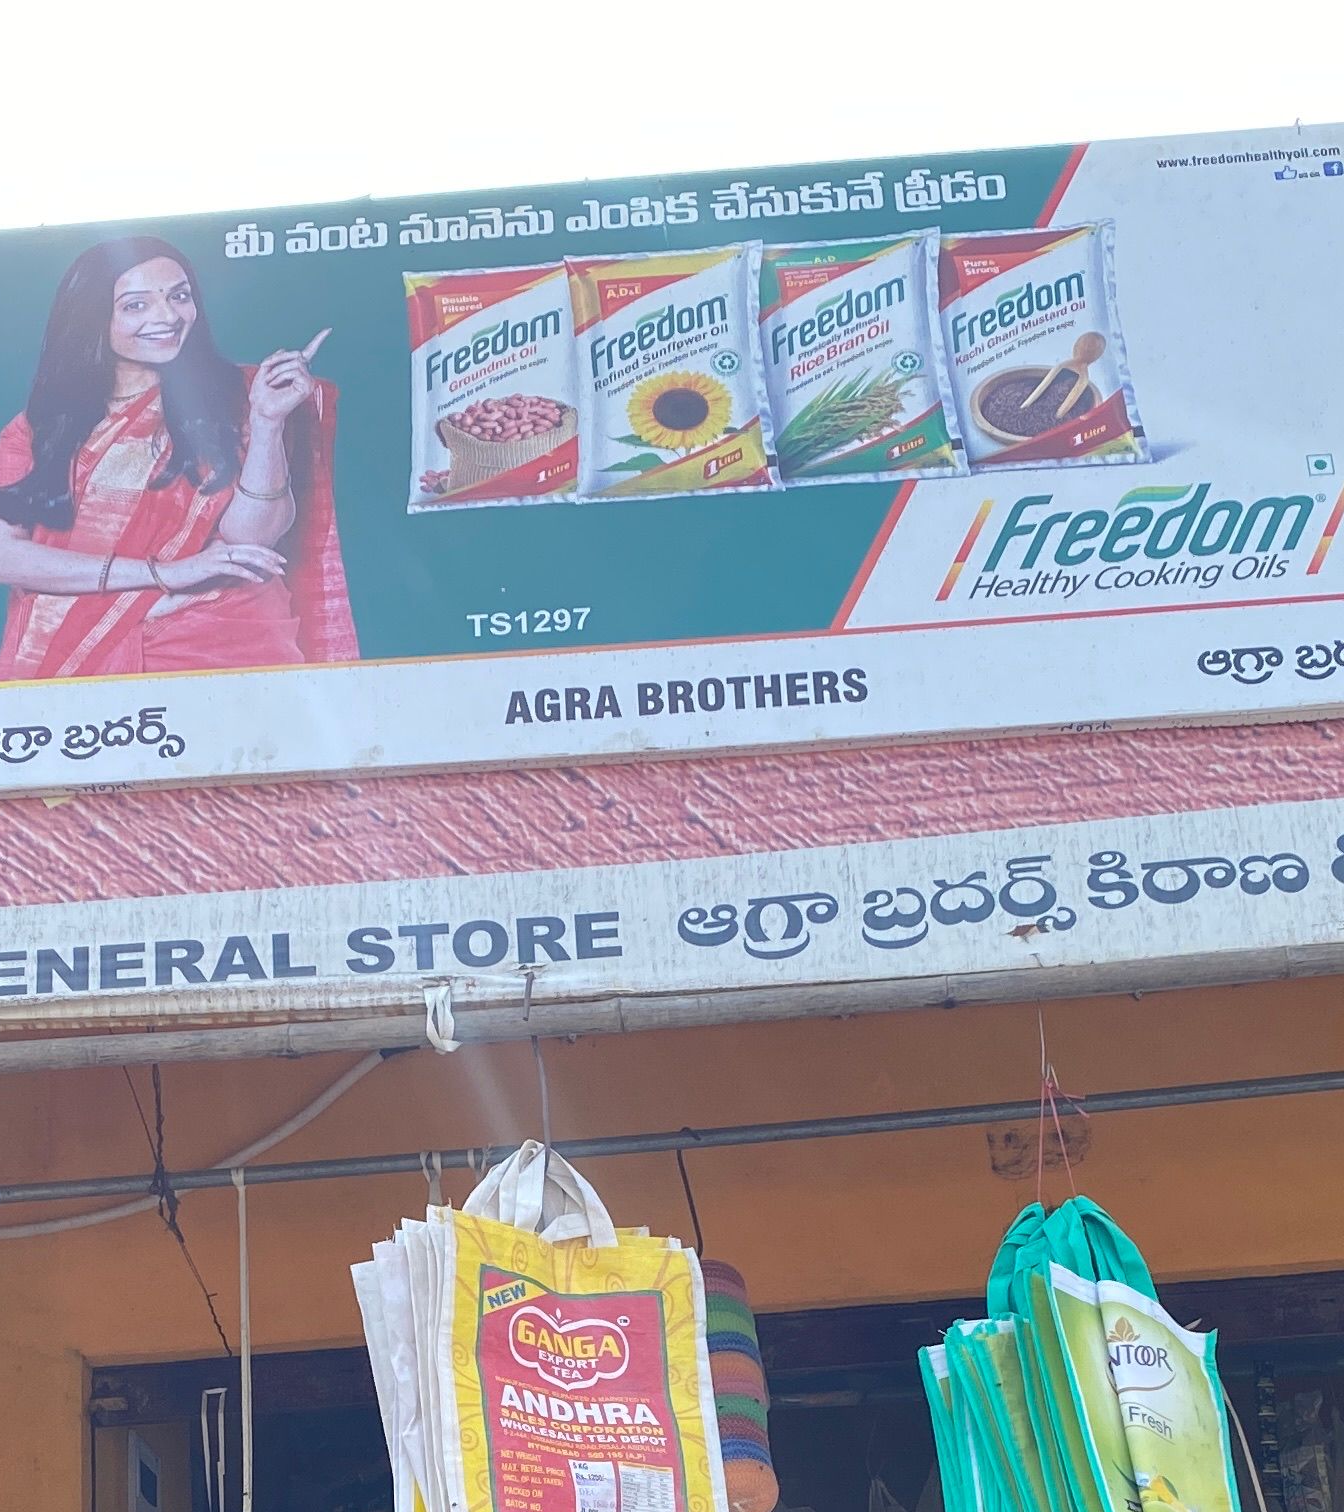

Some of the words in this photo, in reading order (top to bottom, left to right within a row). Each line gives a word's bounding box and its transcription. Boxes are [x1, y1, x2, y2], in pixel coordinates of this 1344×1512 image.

[1156, 146, 1340, 168] www.freedomhealthyoil.com
[224, 223, 274, 259] మీ
[285, 213, 388, 256] వంట
[398, 202, 554, 247] నూనెను
[566, 190, 699, 235] ఎంపిక
[712, 173, 886, 222] చేసుకునే
[590, 293, 728, 379] Freedom
[771, 274, 907, 366] Freedom
[951, 270, 1086, 354] Freedom
[986, 326, 1021, 352] Ghani
[1021, 305, 1069, 335] Mustard
[426, 308, 564, 392] Freedom
[448, 352, 517, 393] Groundnut
[519, 344, 538, 363] Oil
[593, 359, 641, 393] Refined
[641, 332, 709, 366] Sunflower
[789, 351, 826, 382] Rice
[826, 333, 867, 361] Bran
[867, 319, 891, 341] Oil
[983, 482, 1316, 573] Freedom
[969, 572, 1090, 601] Healthy
[1094, 557, 1225, 594] Cooking
[1230, 553, 1290, 582] Oils
[467, 606, 592, 638] TS1297
[1197, 644, 1284, 687] ఆగ్రా
[504, 684, 623, 727] AGRA
[637, 666, 869, 720] BROTHERS
[61, 705, 186, 761] బ్రదర్స్
[676, 890, 840, 960] ఆగ్రా
[861, 854, 1078, 950] బ్రదర్స్
[1087, 847, 1311, 912] కిరాణ
[344, 910, 623, 976] STORE
[486, 1282, 527, 1309] NEW
[517, 1319, 623, 1359] GANGA
[538, 1349, 600, 1370] EXPORT
[551, 1365, 584, 1381] TEA
[500, 1383, 661, 1427] ANDHRA
[501, 1407, 547, 1428] SALES
[549, 1419, 665, 1437] CORPORATION
[1129, 1405, 1174, 1439] Fresh
[499, 1417, 584, 1444] WHOLESALE
[585, 1433, 618, 1445] TEA
[620, 1434, 668, 1447] DEPOT
